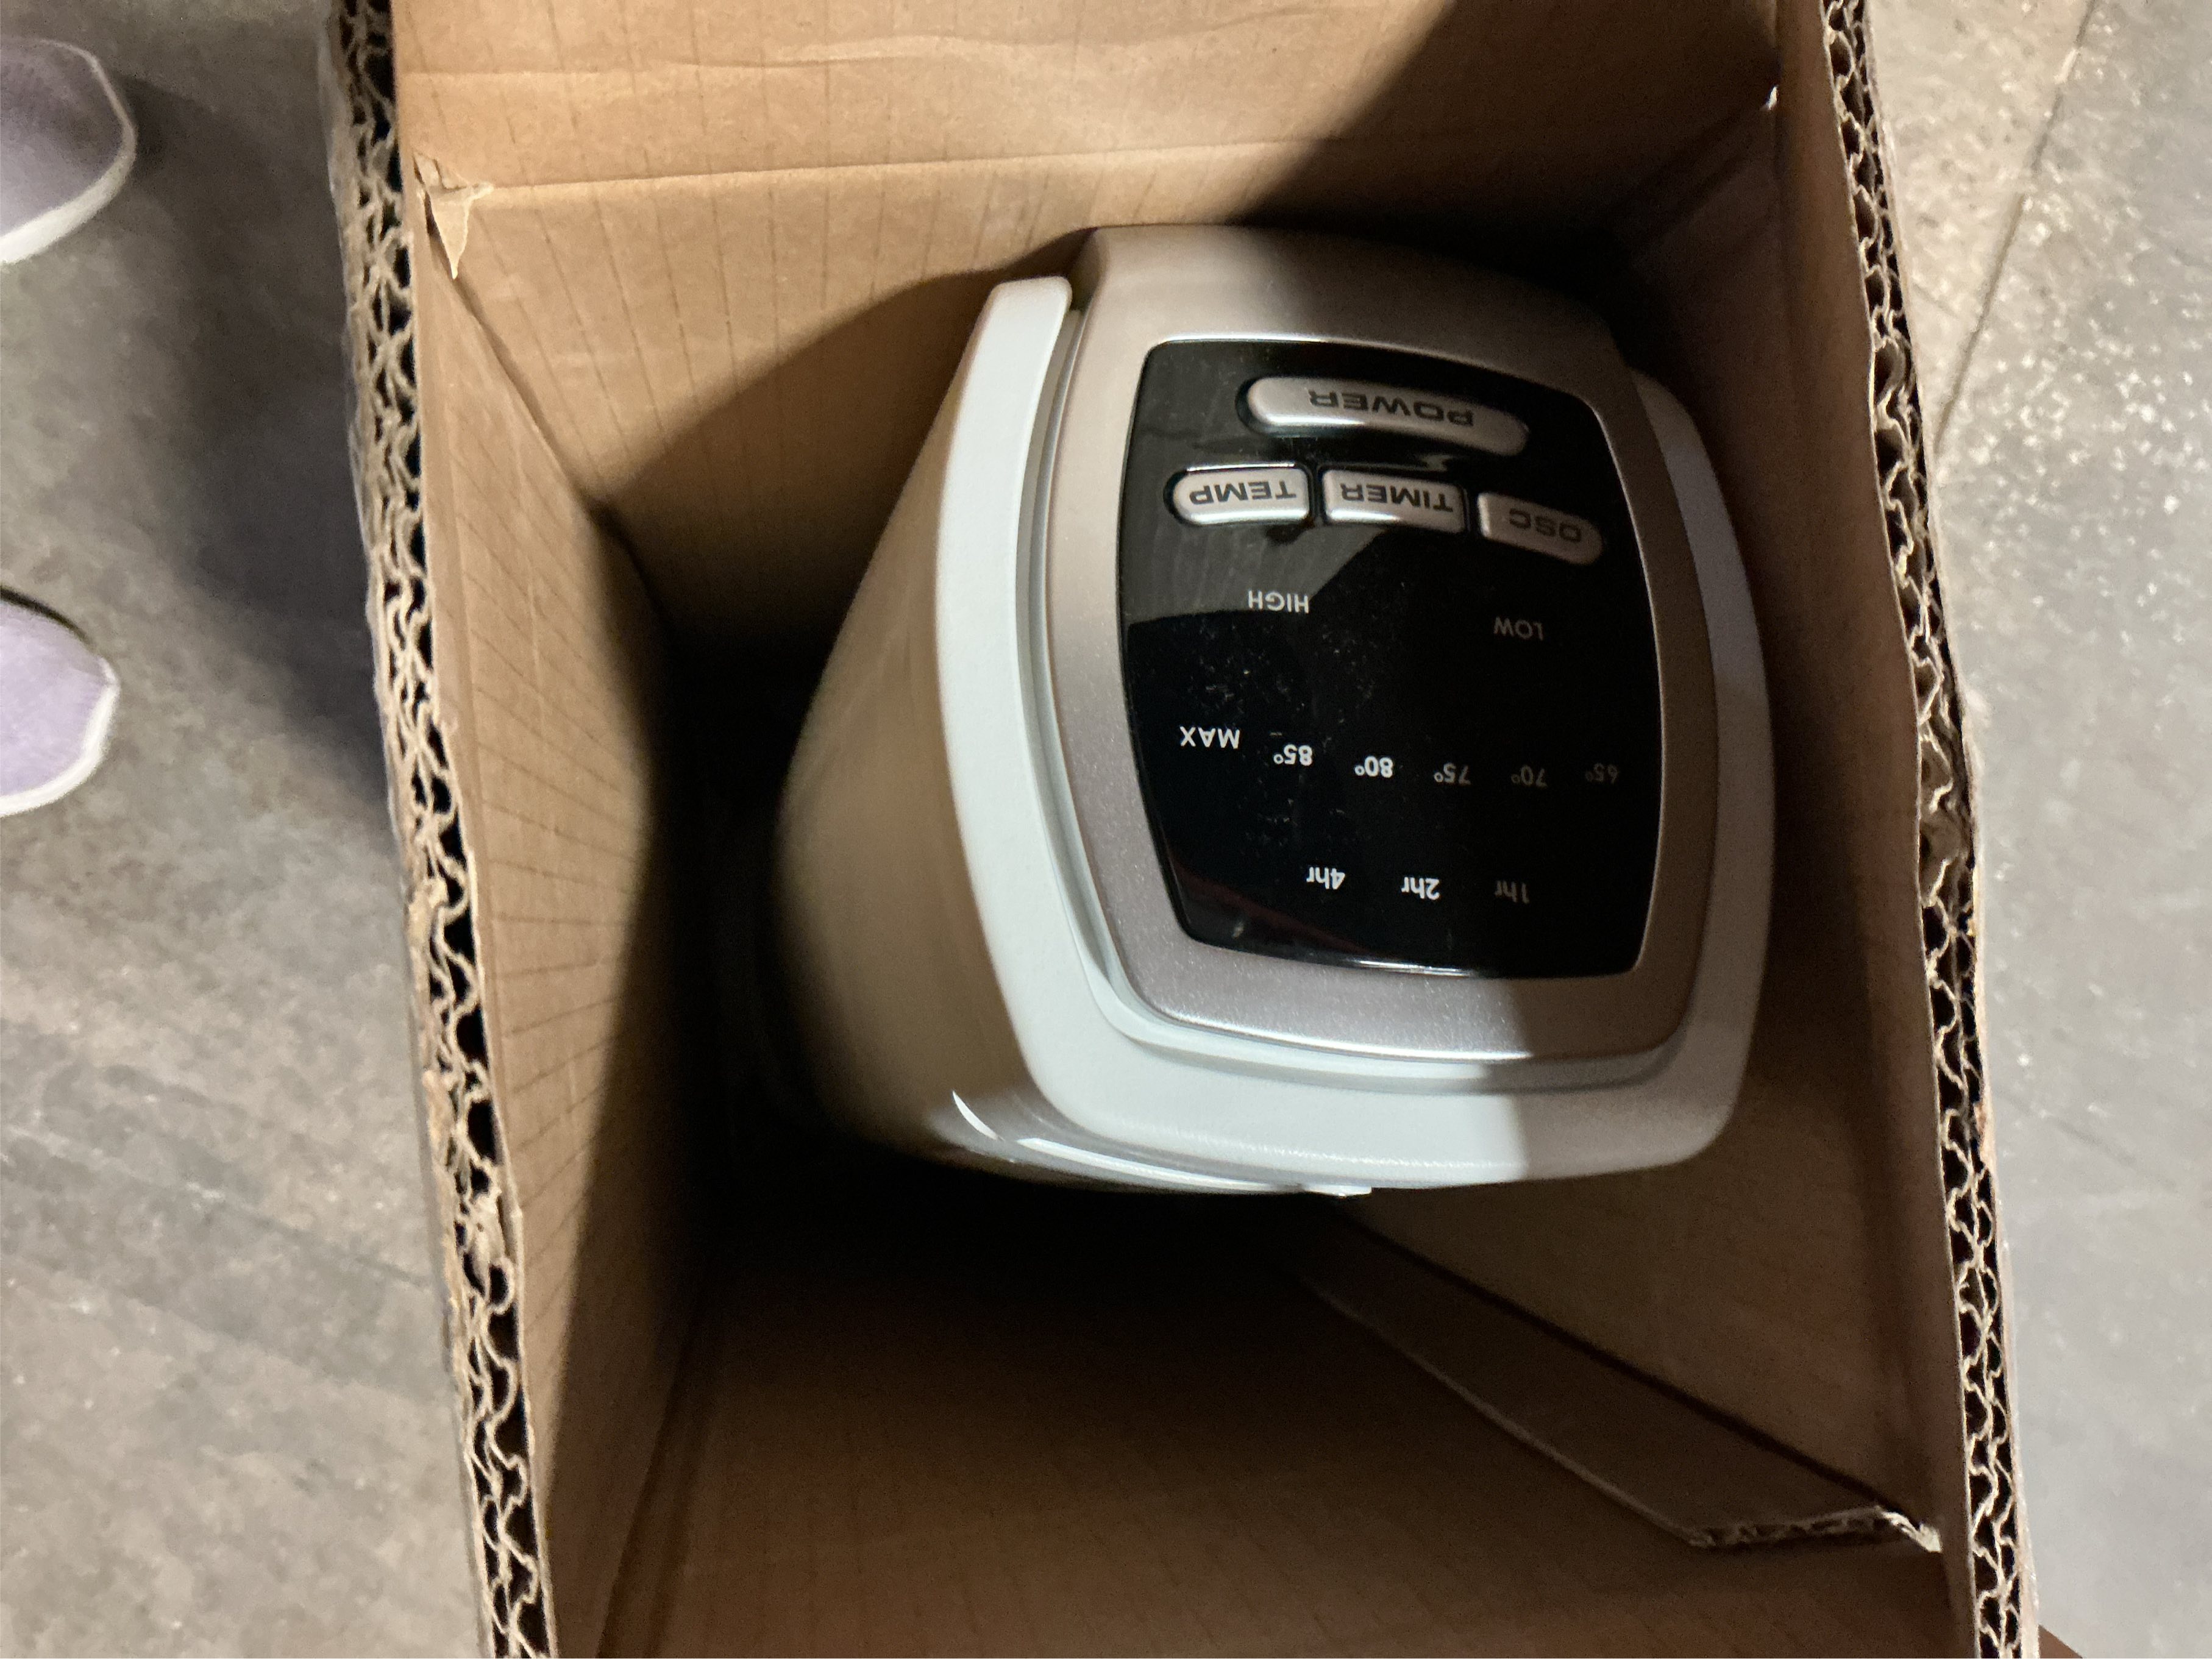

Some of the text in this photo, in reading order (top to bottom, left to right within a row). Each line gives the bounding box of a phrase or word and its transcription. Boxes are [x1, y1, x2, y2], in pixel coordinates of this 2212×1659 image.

[1308, 389, 1474, 427] POWER
[1189, 481, 1297, 505] TEMP
[1340, 483, 1453, 511] TIMER
[1509, 508, 1582, 542] OSC
[1248, 589, 1309, 614] HIGH
[1493, 616, 1545, 641] LOW
[1179, 726, 1240, 750] MAX
[1306, 866, 1345, 890] 4hr
[1401, 877, 1440, 900] 2hr
[1494, 880, 1529, 903] 1hr
